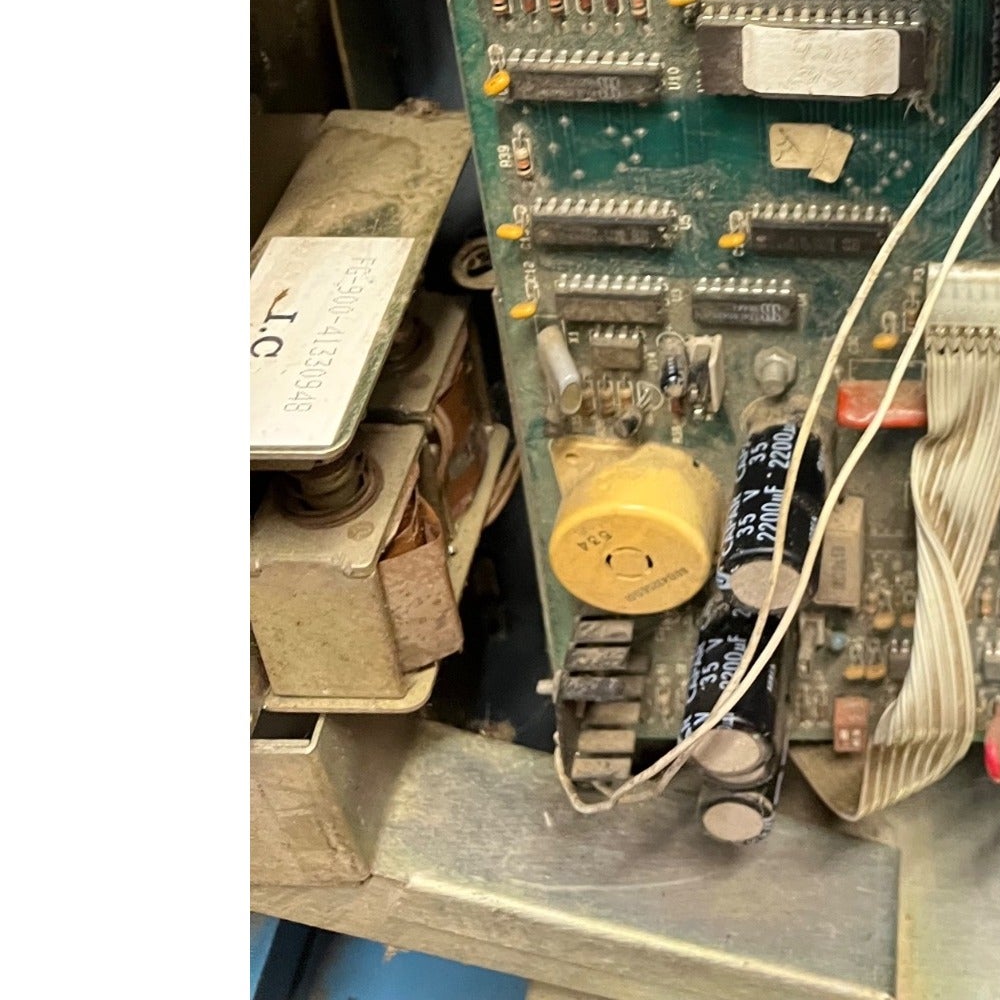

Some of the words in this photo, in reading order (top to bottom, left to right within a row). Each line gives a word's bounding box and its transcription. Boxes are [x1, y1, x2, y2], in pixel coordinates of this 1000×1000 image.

[666, 66, 682, 91] U10
[749, 441, 768, 466] 35
[743, 488, 761, 503] V
[736, 512, 757, 539] 35
[706, 638, 724, 651] V
[701, 661, 720, 692] 35
